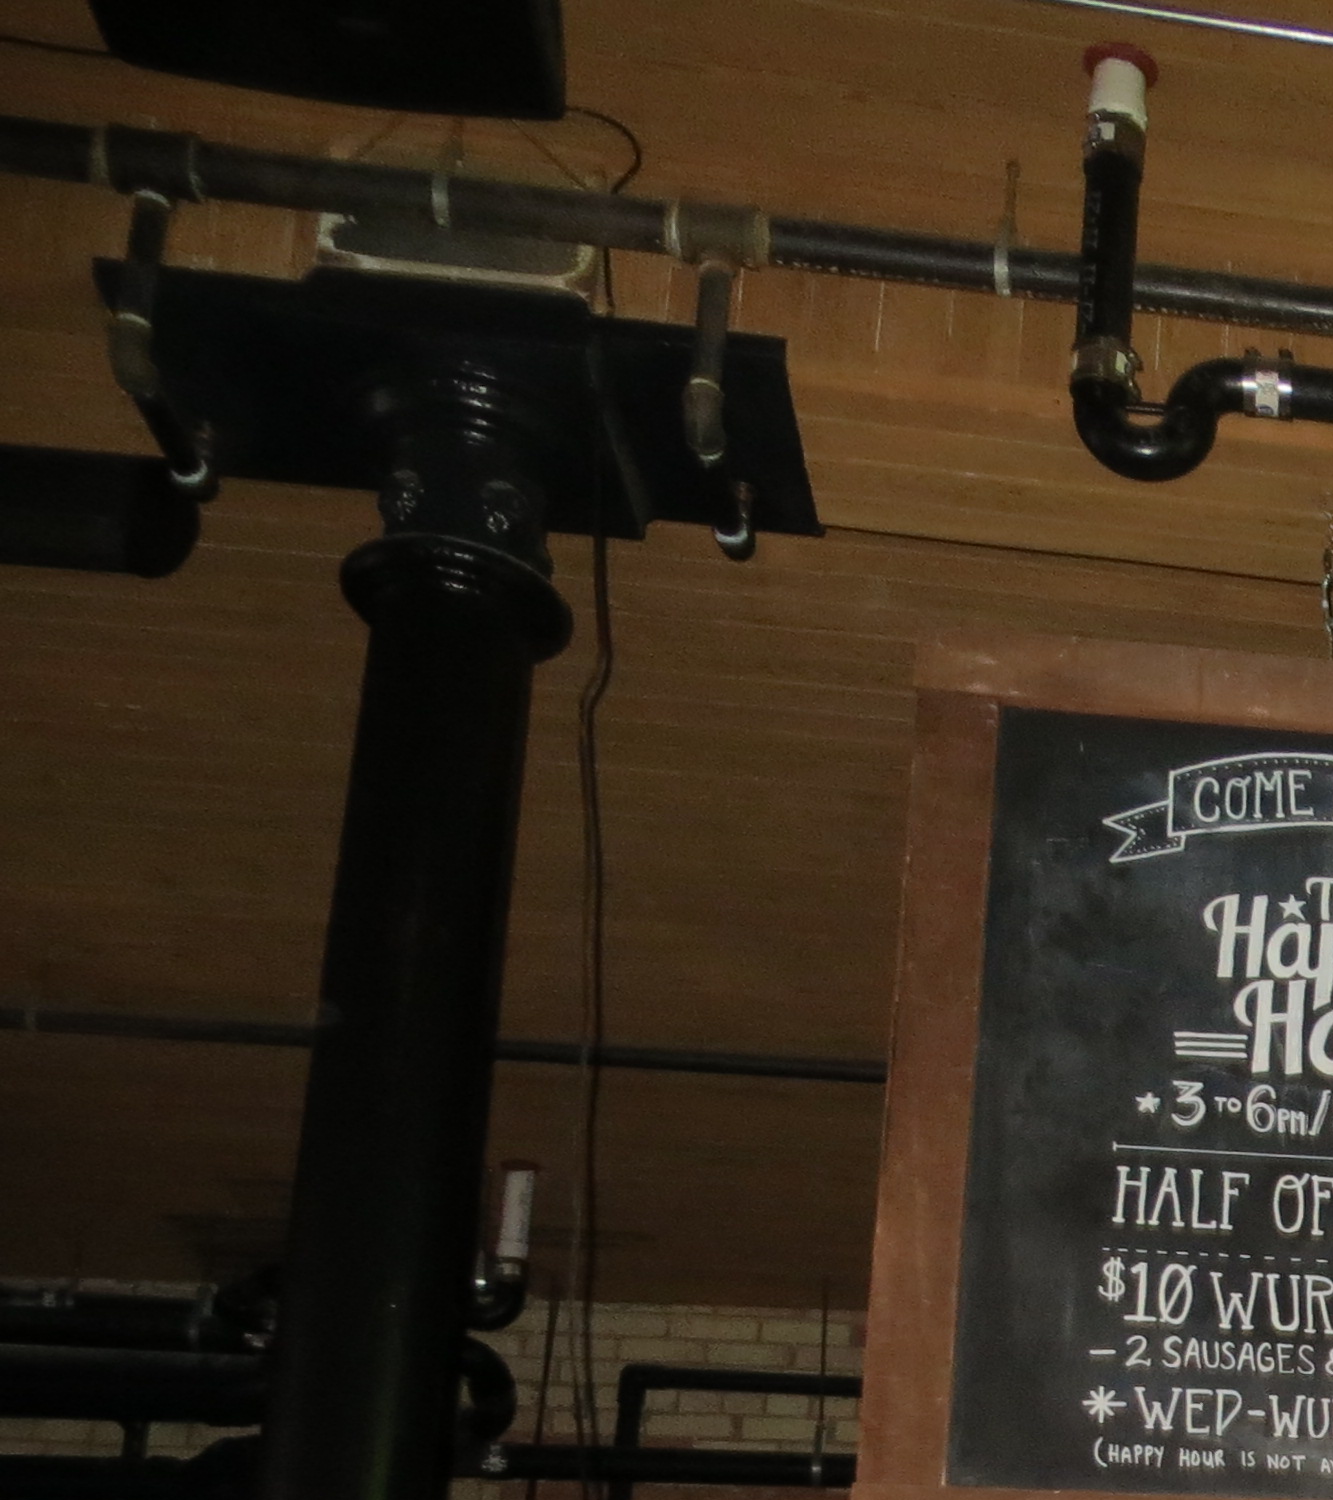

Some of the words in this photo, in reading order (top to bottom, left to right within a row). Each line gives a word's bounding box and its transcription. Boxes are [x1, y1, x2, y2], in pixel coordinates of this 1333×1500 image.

[1193, 770, 1312, 823] COME
[1171, 1080, 1205, 1126] 3
[1214, 1097, 1241, 1114] TO
[1111, 1166, 1250, 1232] HALF
[1099, 1257, 1196, 1323] $10
[1126, 1335, 1150, 1367] 2
[1163, 1337, 1315, 1375] SAUSAGES
[1179, 1447, 1224, 1468] HOUR
[1241, 1454, 1255, 1467] IS
[1267, 1453, 1306, 1472] NOT
